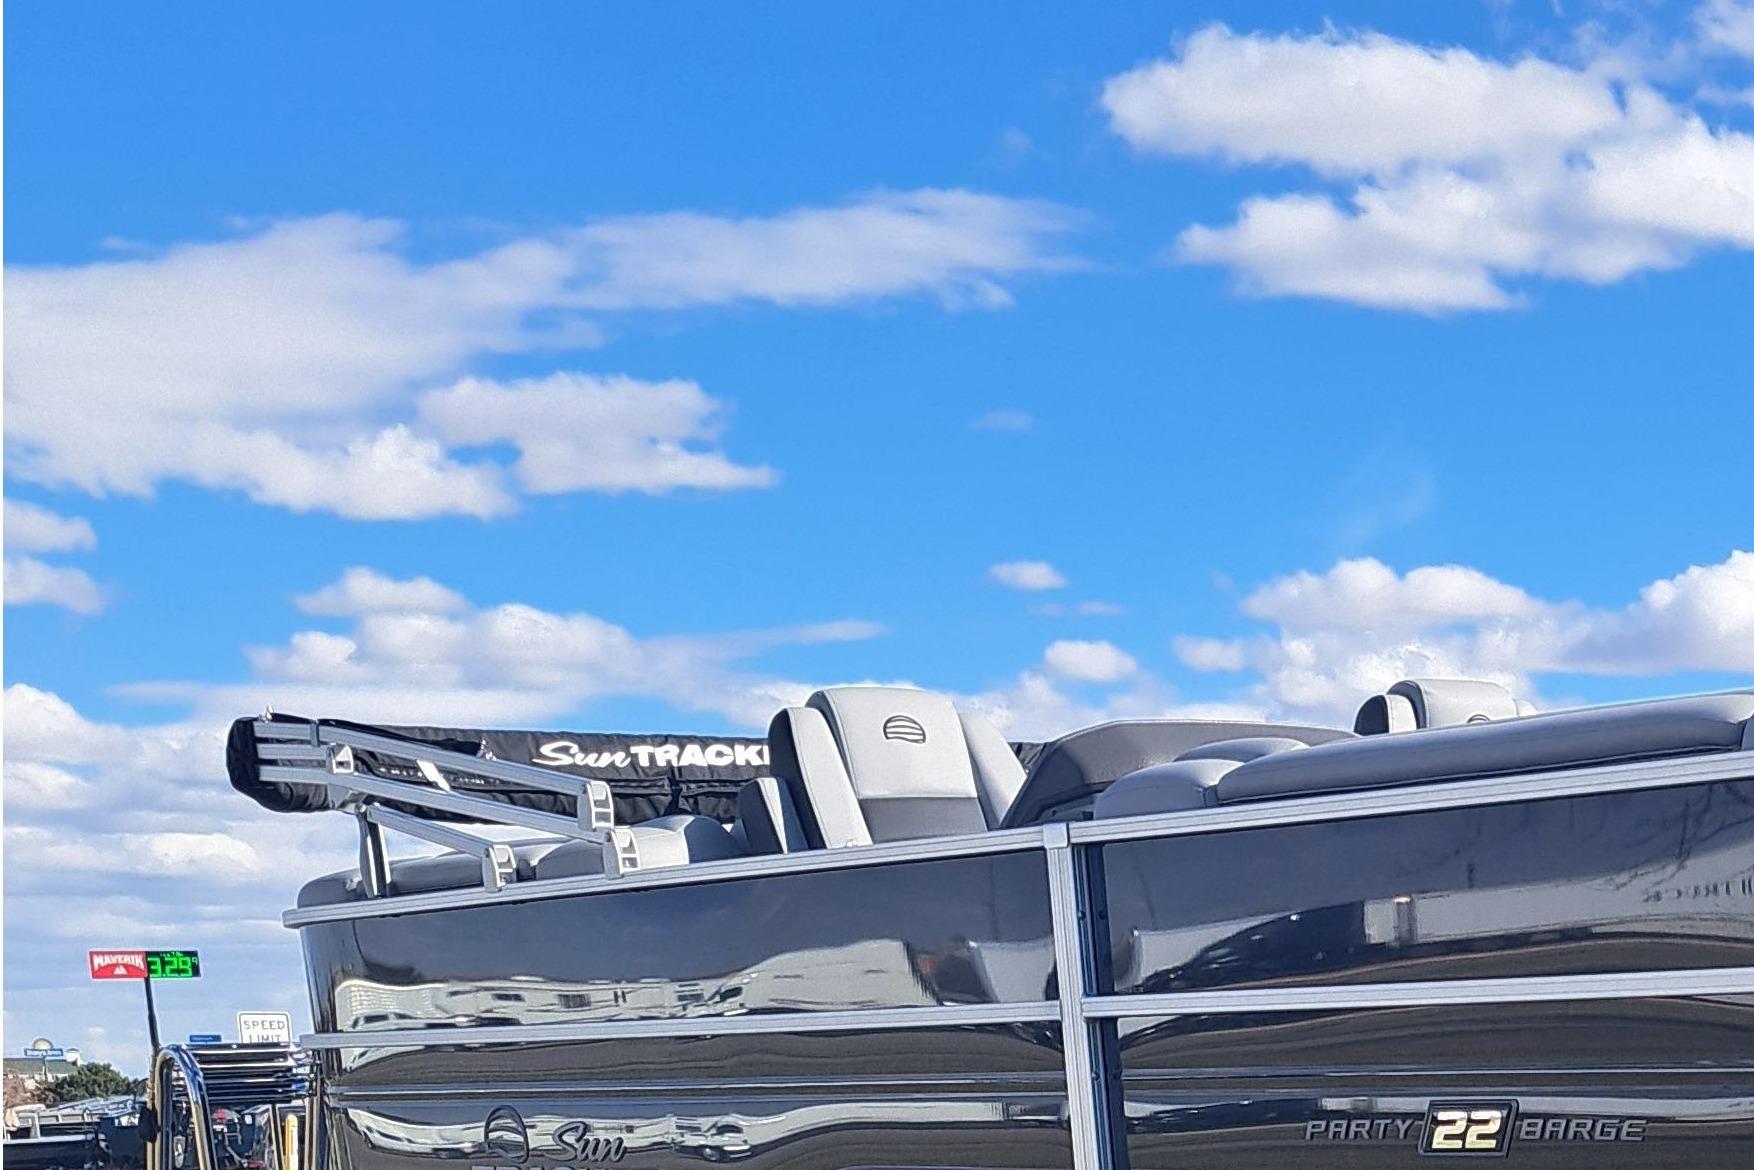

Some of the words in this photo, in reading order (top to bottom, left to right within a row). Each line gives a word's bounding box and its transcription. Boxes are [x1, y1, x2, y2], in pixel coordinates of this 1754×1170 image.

[532, 741, 630, 768] Sun
[630, 743, 770, 768] TRACK
[93, 954, 145, 971] MAVERIK
[243, 1020, 285, 1030] SPEED
[544, 1121, 627, 1163] Sun
[1305, 1119, 1416, 1141] PARTY
[1431, 1110, 1502, 1149] 22
[1519, 1118, 1648, 1142] BARGE
